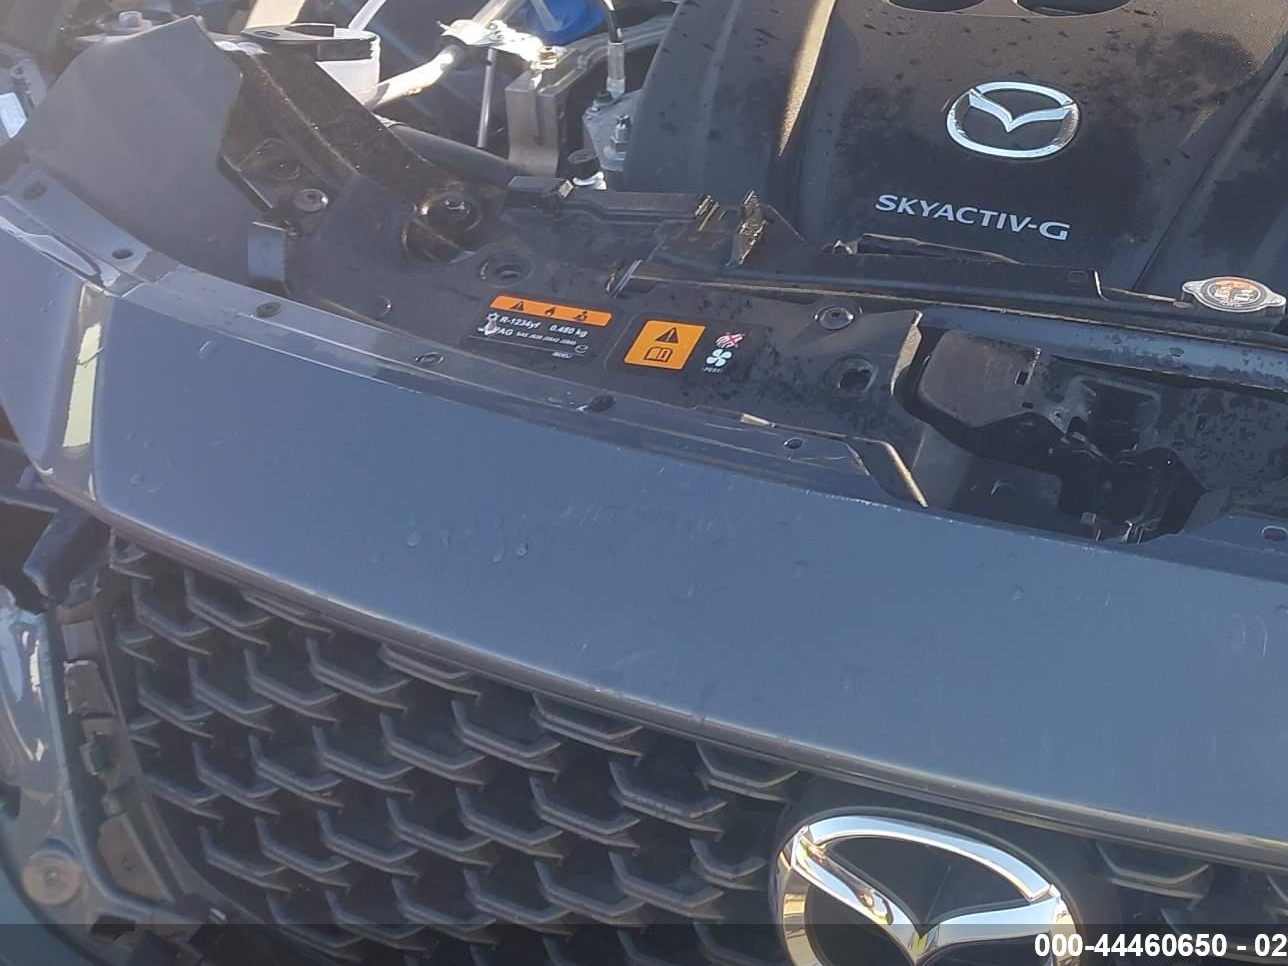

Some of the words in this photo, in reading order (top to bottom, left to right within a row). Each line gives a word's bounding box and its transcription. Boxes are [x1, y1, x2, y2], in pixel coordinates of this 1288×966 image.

[874, 193, 1071, 241] SKYACTIV-G
[499, 315, 542, 330] R-1234yf
[574, 328, 589, 338] kg
